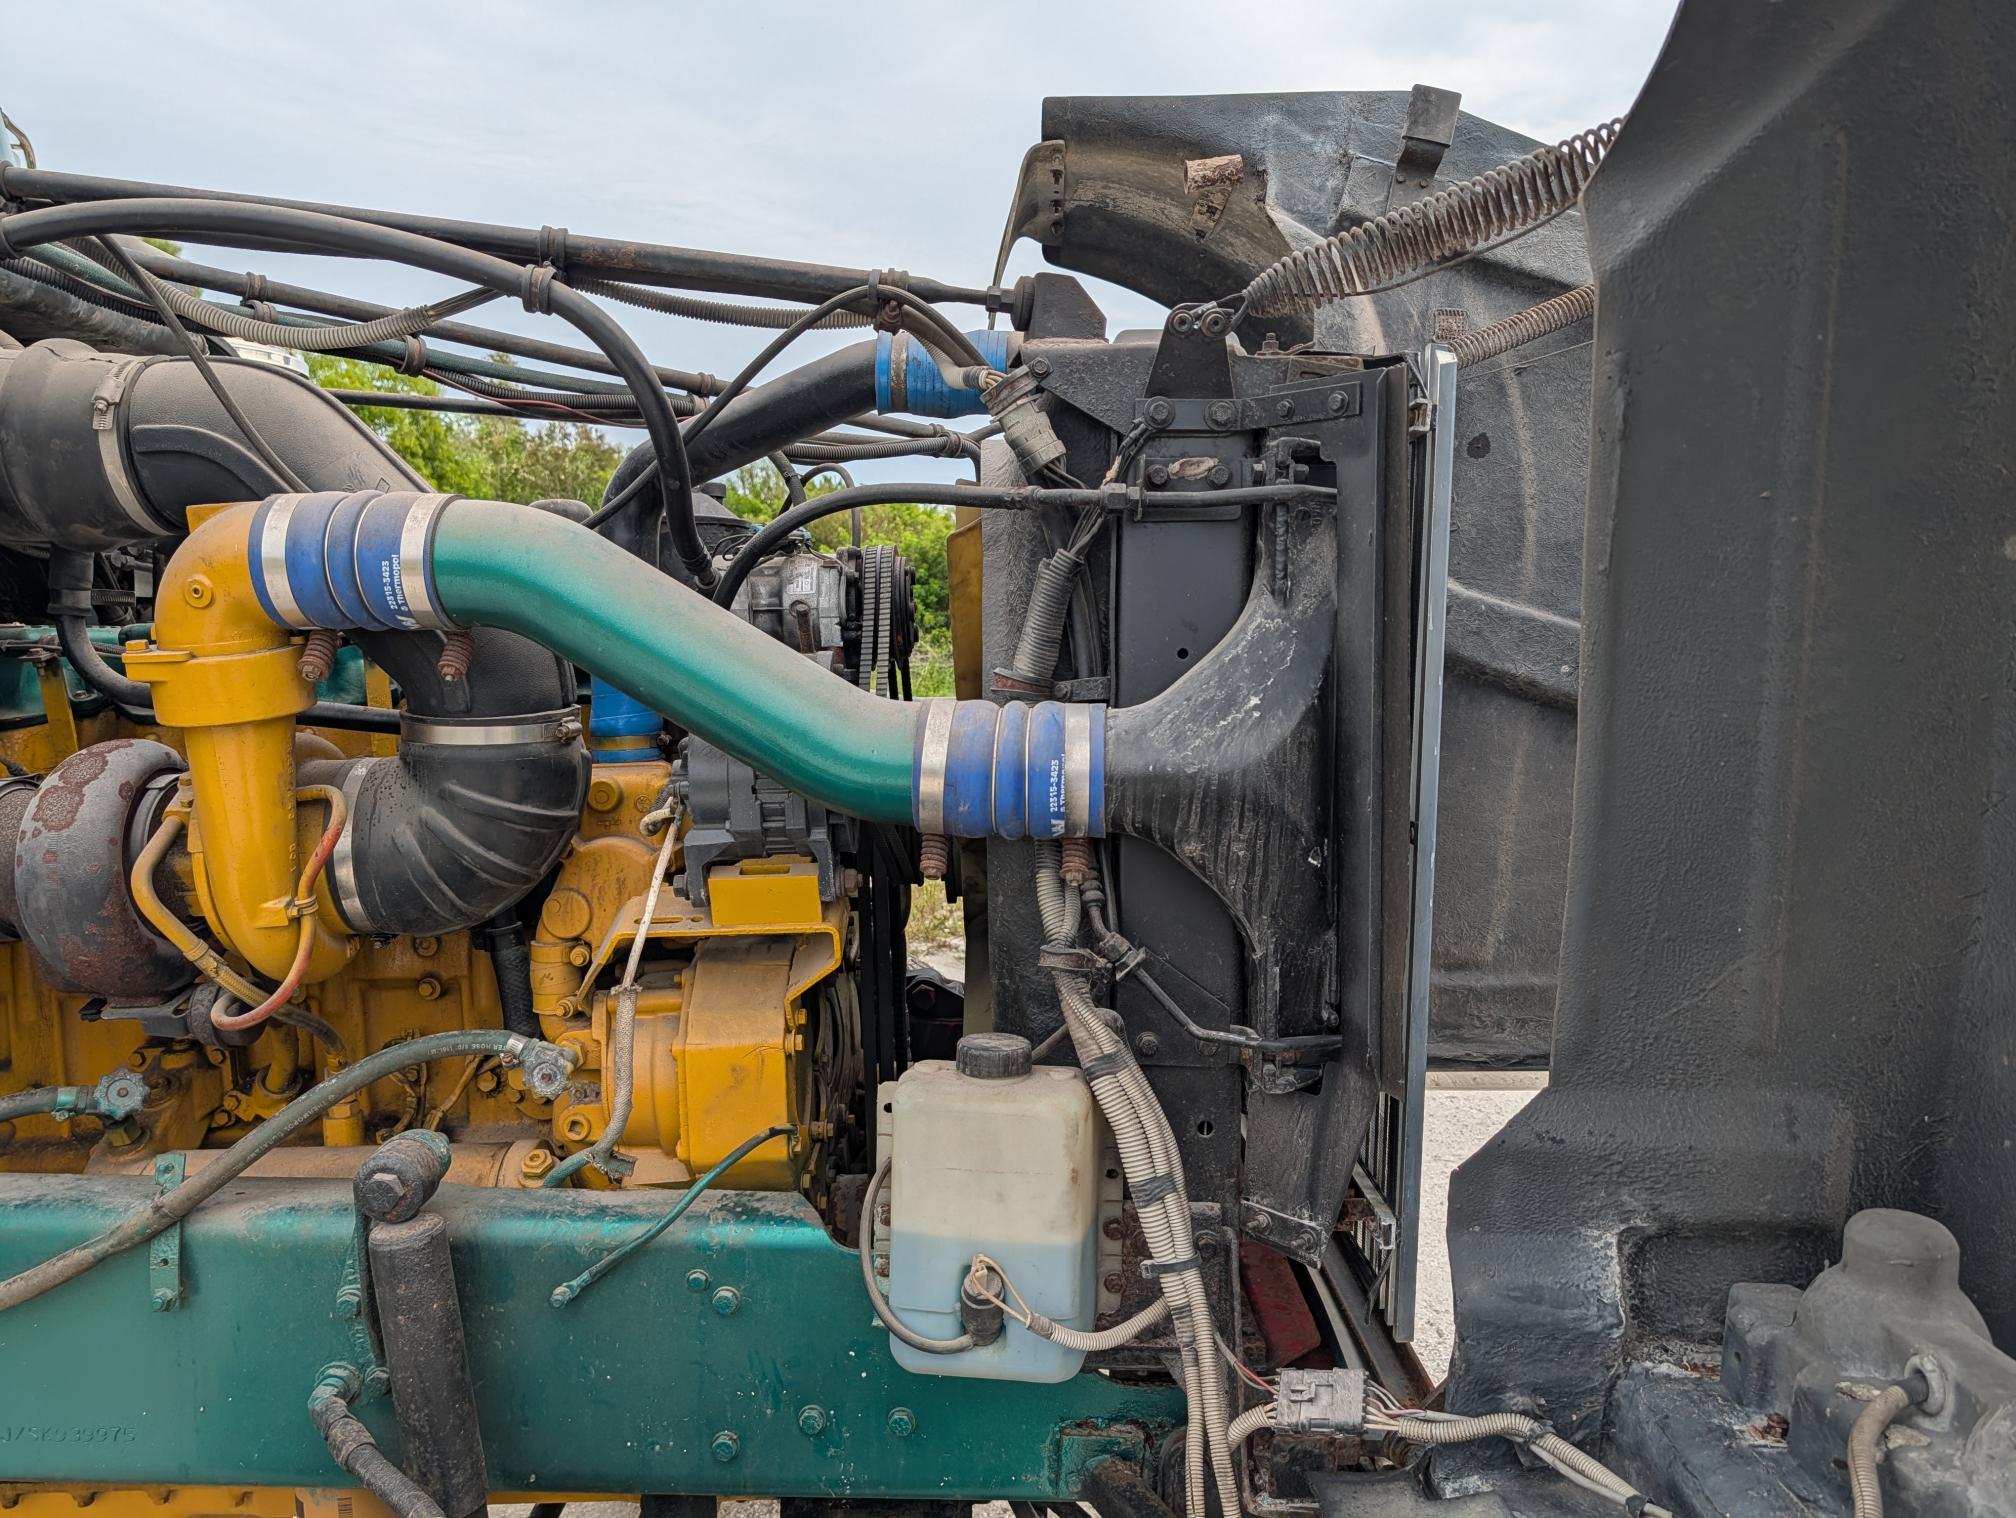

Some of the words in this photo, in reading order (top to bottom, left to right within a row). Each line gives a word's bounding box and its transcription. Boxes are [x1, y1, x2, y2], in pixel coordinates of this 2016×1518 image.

[382, 560, 398, 610] 22315-3423
[391, 554, 405, 605] Thermopol
[1050, 760, 1059, 813] 22315-3423
